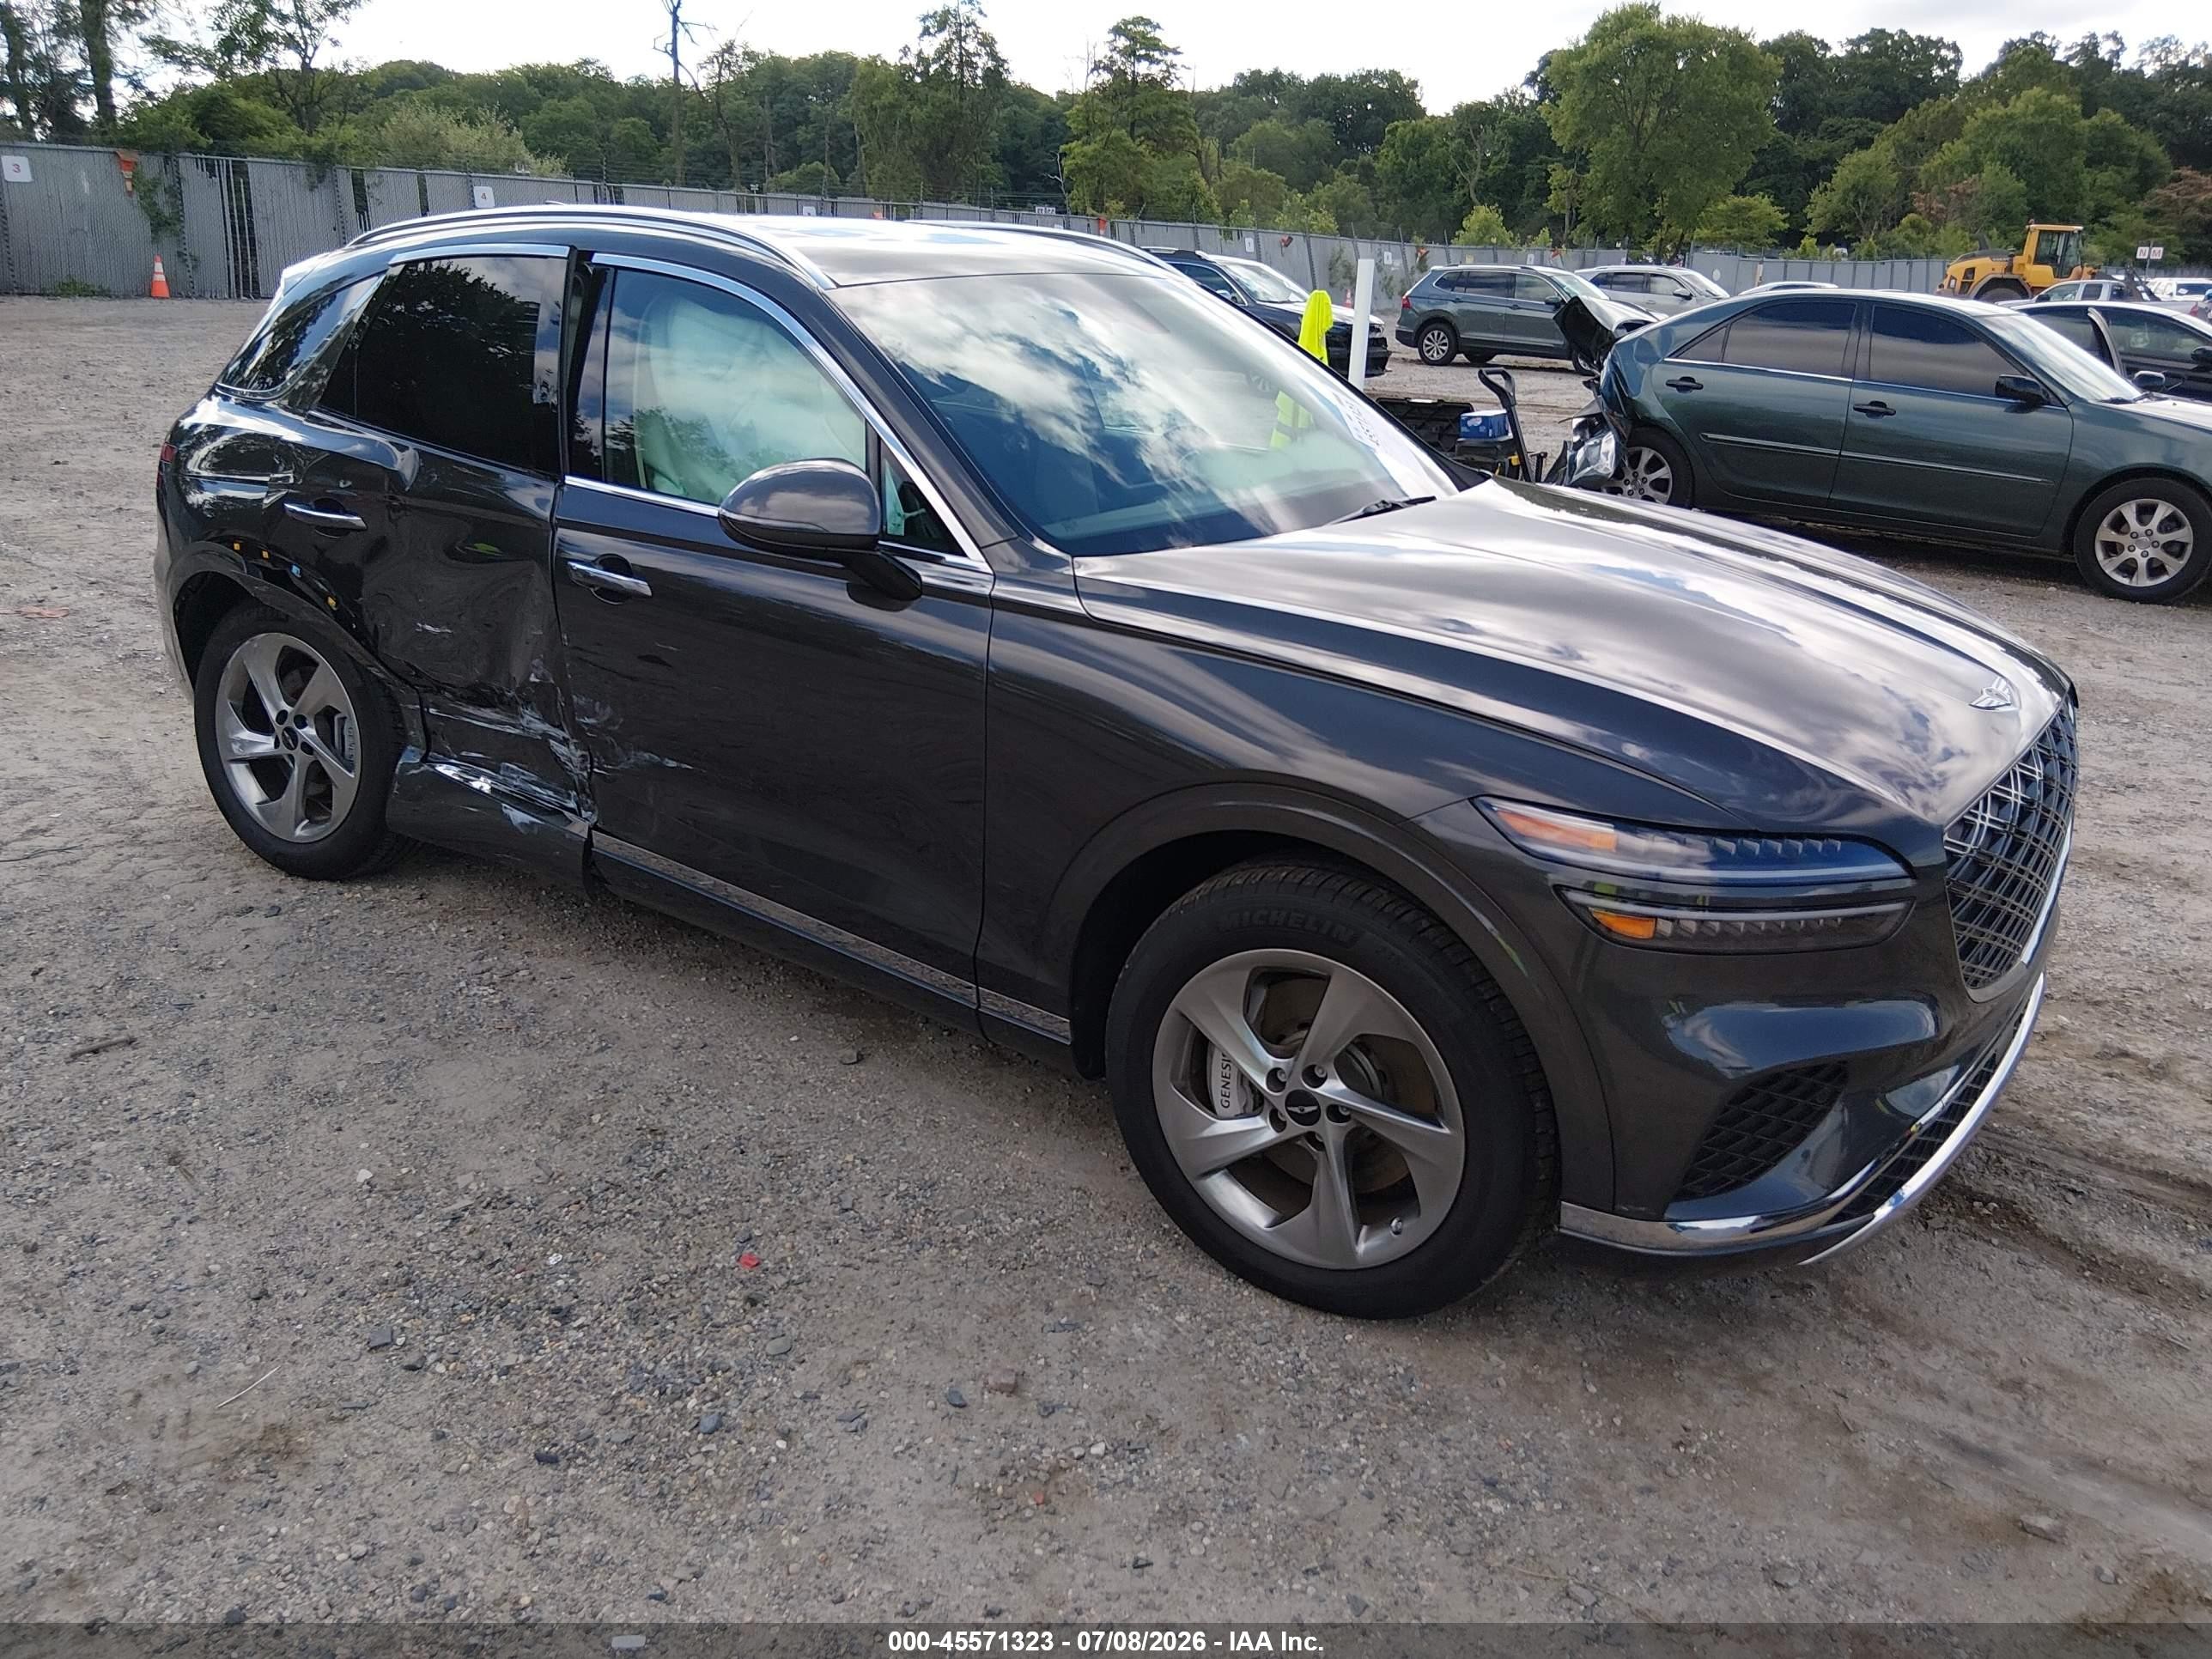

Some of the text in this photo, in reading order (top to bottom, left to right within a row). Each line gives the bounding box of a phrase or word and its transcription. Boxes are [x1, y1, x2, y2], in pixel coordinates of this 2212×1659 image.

[12, 163, 21, 173] 3
[2139, 248, 2147, 257] N
[2153, 249, 2161, 258] M
[1219, 908, 1357, 945] MICHELIN
